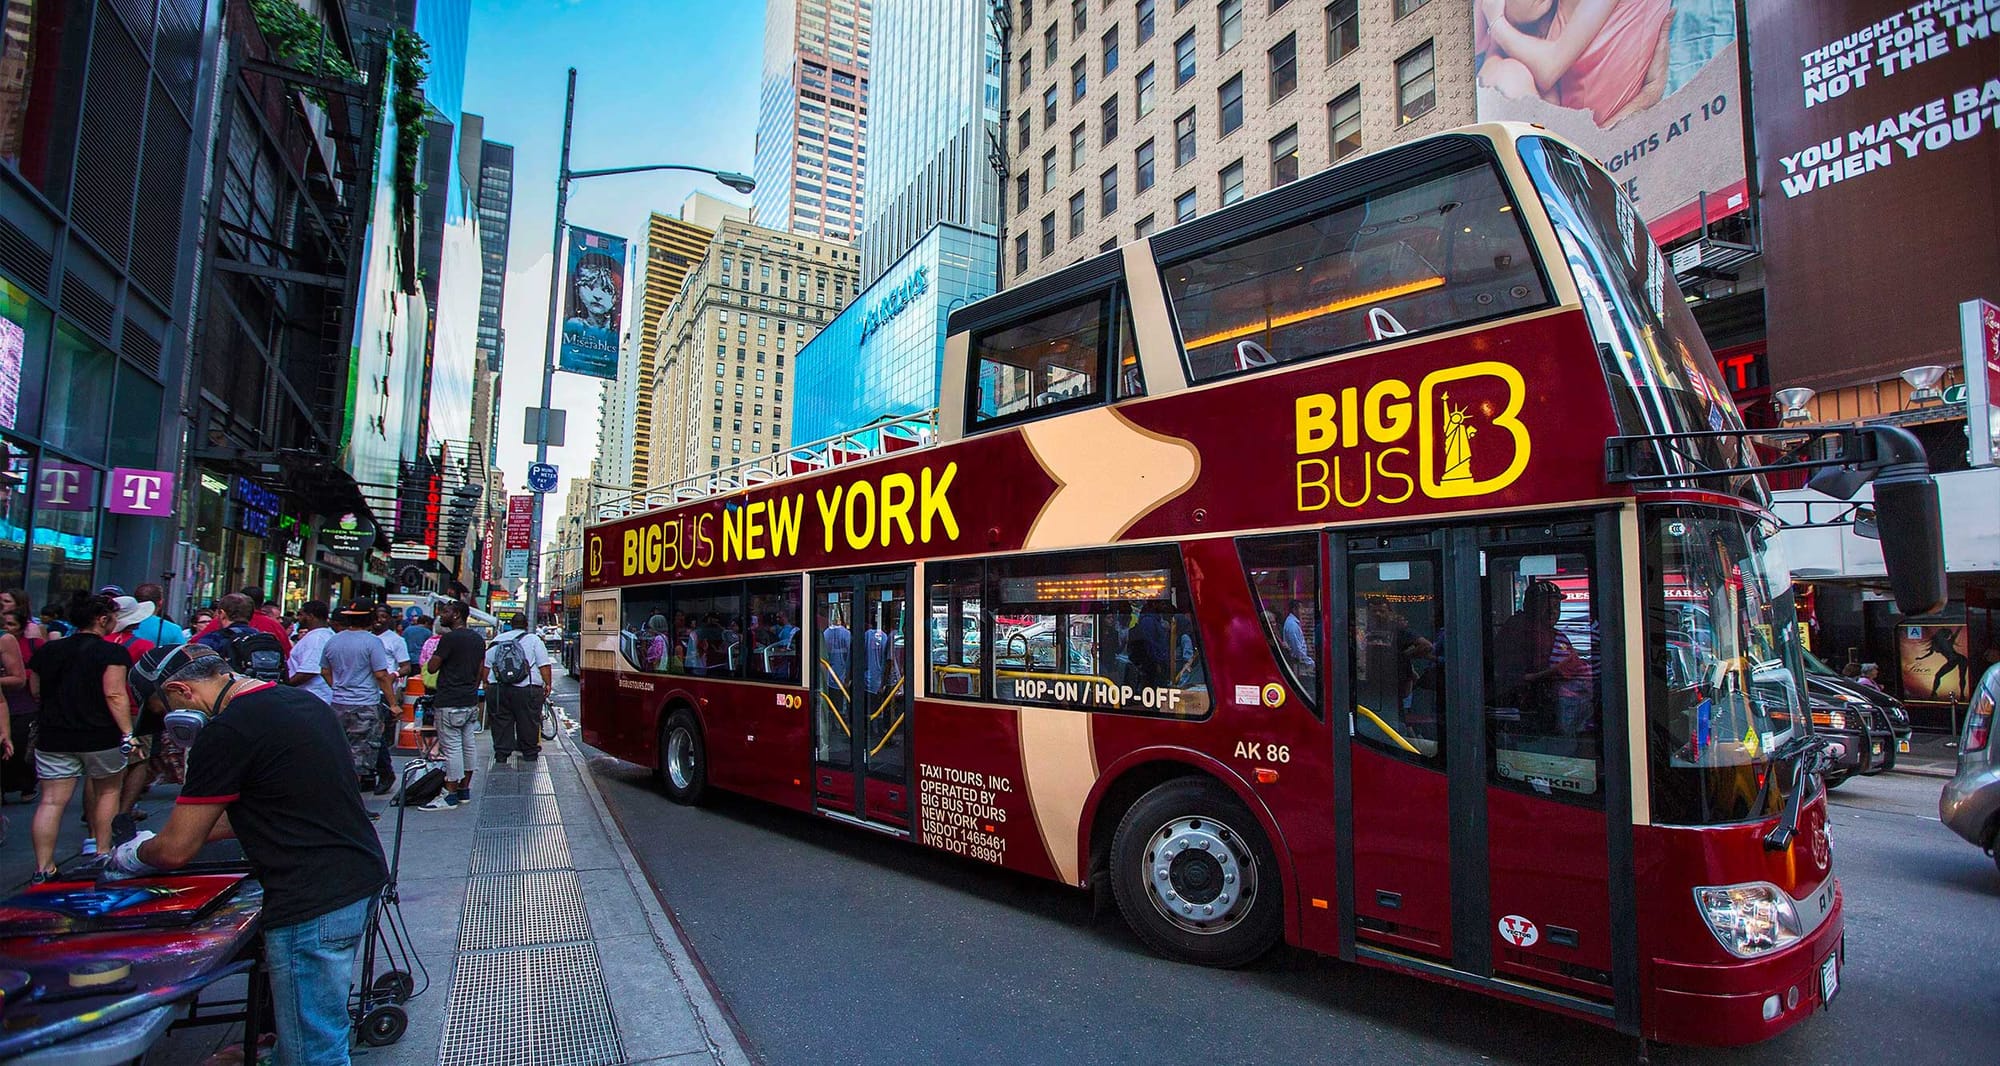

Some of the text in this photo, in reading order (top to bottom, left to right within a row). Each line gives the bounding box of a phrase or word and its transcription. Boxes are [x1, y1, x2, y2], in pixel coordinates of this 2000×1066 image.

[1801, 12, 1905, 68] THOUGHT
[1802, 43, 1874, 87] RENT
[1878, 18, 1936, 56] FOR
[1804, 63, 1871, 109] NOT
[1876, 31, 1950, 77] THE
[1666, 113, 1692, 143] AT
[1700, 94, 1727, 121] 10
[1779, 136, 1843, 175] YOU
[1848, 98, 1947, 152] MAKE
[1780, 143, 1892, 199] WHEN
[1296, 379, 1413, 455] BIG
[1296, 447, 1415, 511] BUS
[722, 493, 804, 563] NEW
[816, 462, 960, 553] YORK
[1911, 628, 1919, 636] A
[1015, 679, 1078, 702] HOP-ON
[1096, 684, 1181, 710] HOP-OFF
[1234, 741, 1290, 763] AK 86
[920, 763, 1013, 792] TAXI TOURS, INC.
[921, 780, 996, 806] OPERATED BY
[921, 793, 1006, 822] BIG BUS TOURS
[921, 806, 978, 830] NEW YORK
[922, 819, 1006, 851] USDOT 1465461
[923, 832, 1003, 865] NYS DOT 38991
[1505, 928, 1532, 939] VECTOR
